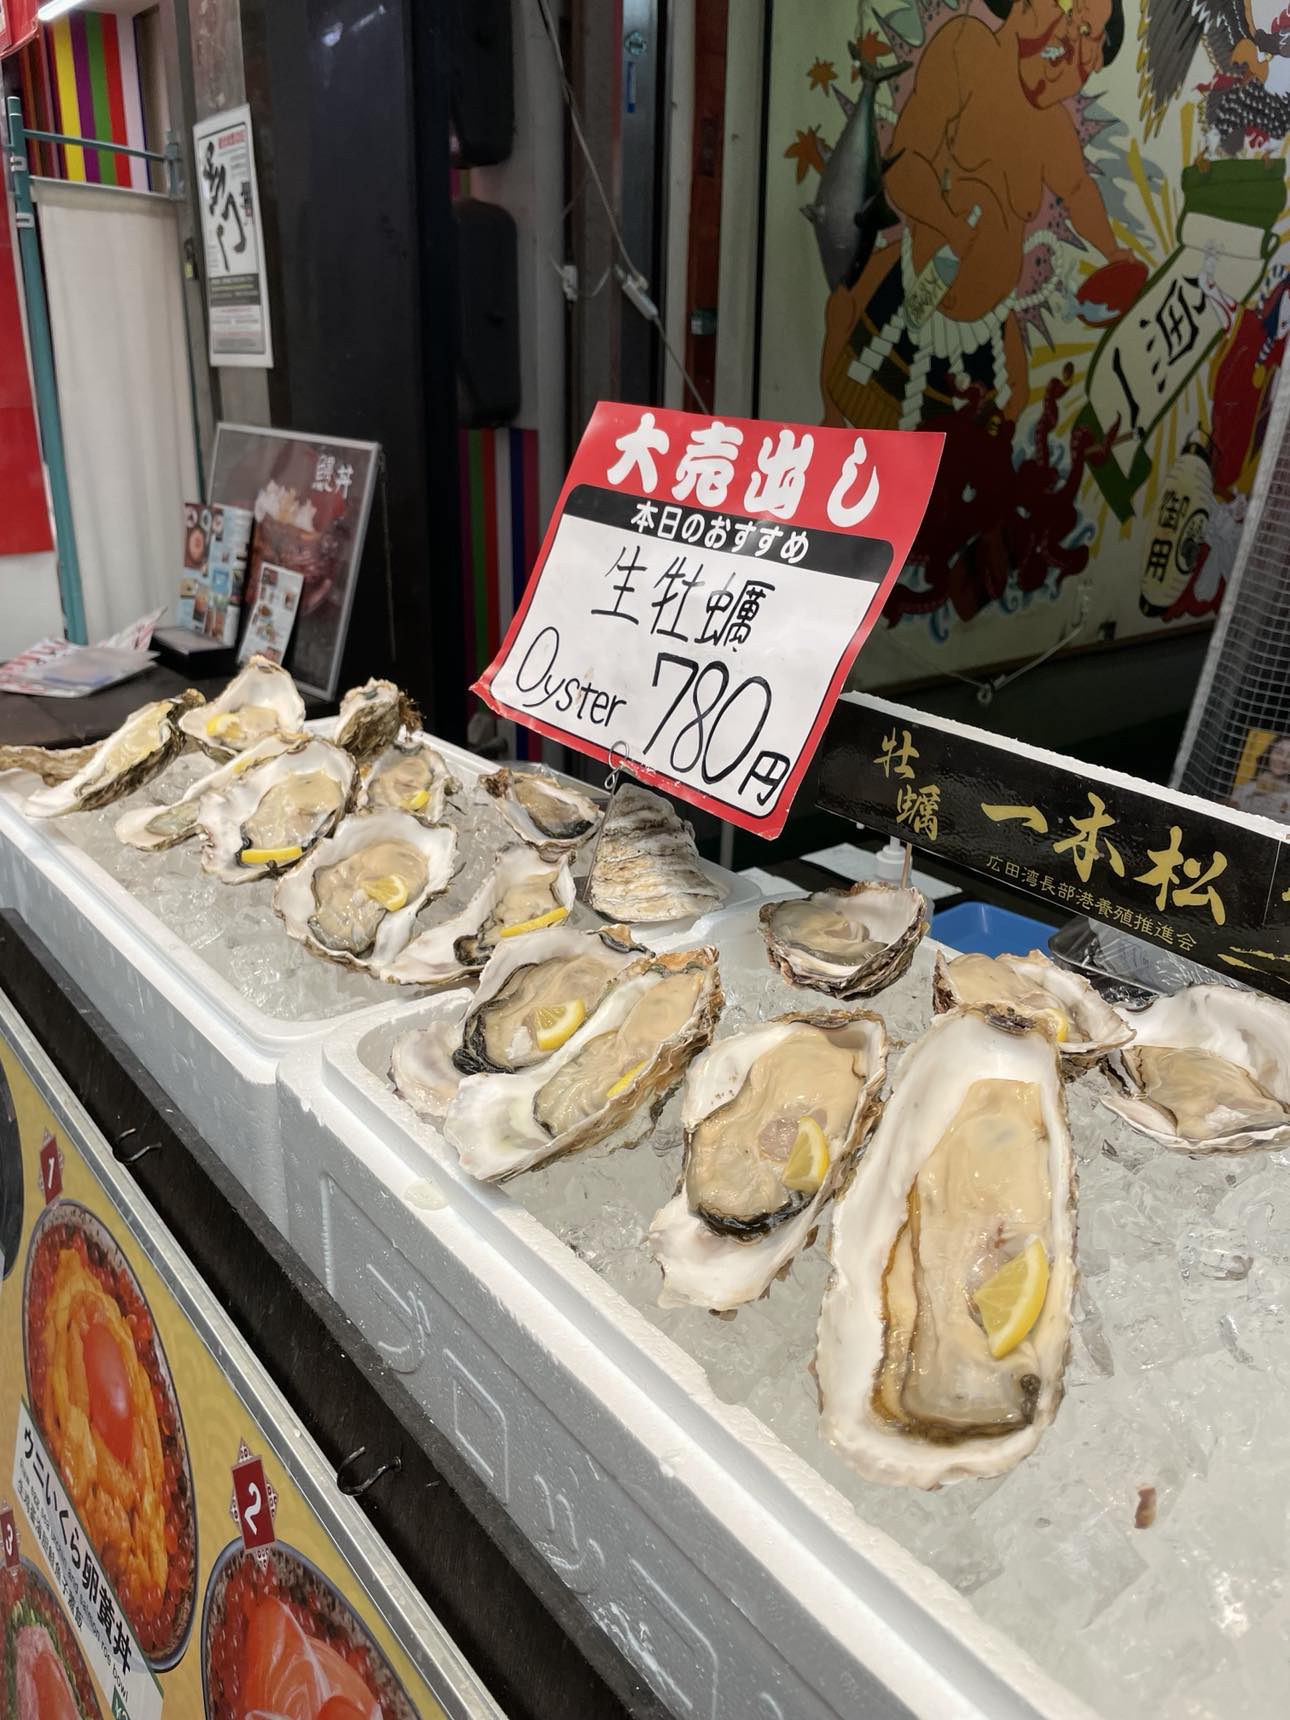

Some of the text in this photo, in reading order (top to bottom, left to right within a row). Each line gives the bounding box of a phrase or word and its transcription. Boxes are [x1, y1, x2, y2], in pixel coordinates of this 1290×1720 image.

[606, 412, 880, 528] 大売出し
[630, 501, 810, 564] 本日のおすすめ
[590, 545, 776, 652] 生牡蠣
[515, 626, 792, 805] Oyster 780円
[873, 727, 941, 841] 牡蠣
[980, 791, 1229, 926] 一本松
[985, 854, 1198, 951] 広田湾長部港養殖推進会
[47, 1156, 55, 1190] 1
[5, 1523, 14, 1556] 3
[23, 1426, 132, 1676] ウニいくら卵黄丼
[244, 1482, 262, 1535] 2
[100, 1640, 112, 1666] roe
[112, 1663, 130, 1702] bowl
